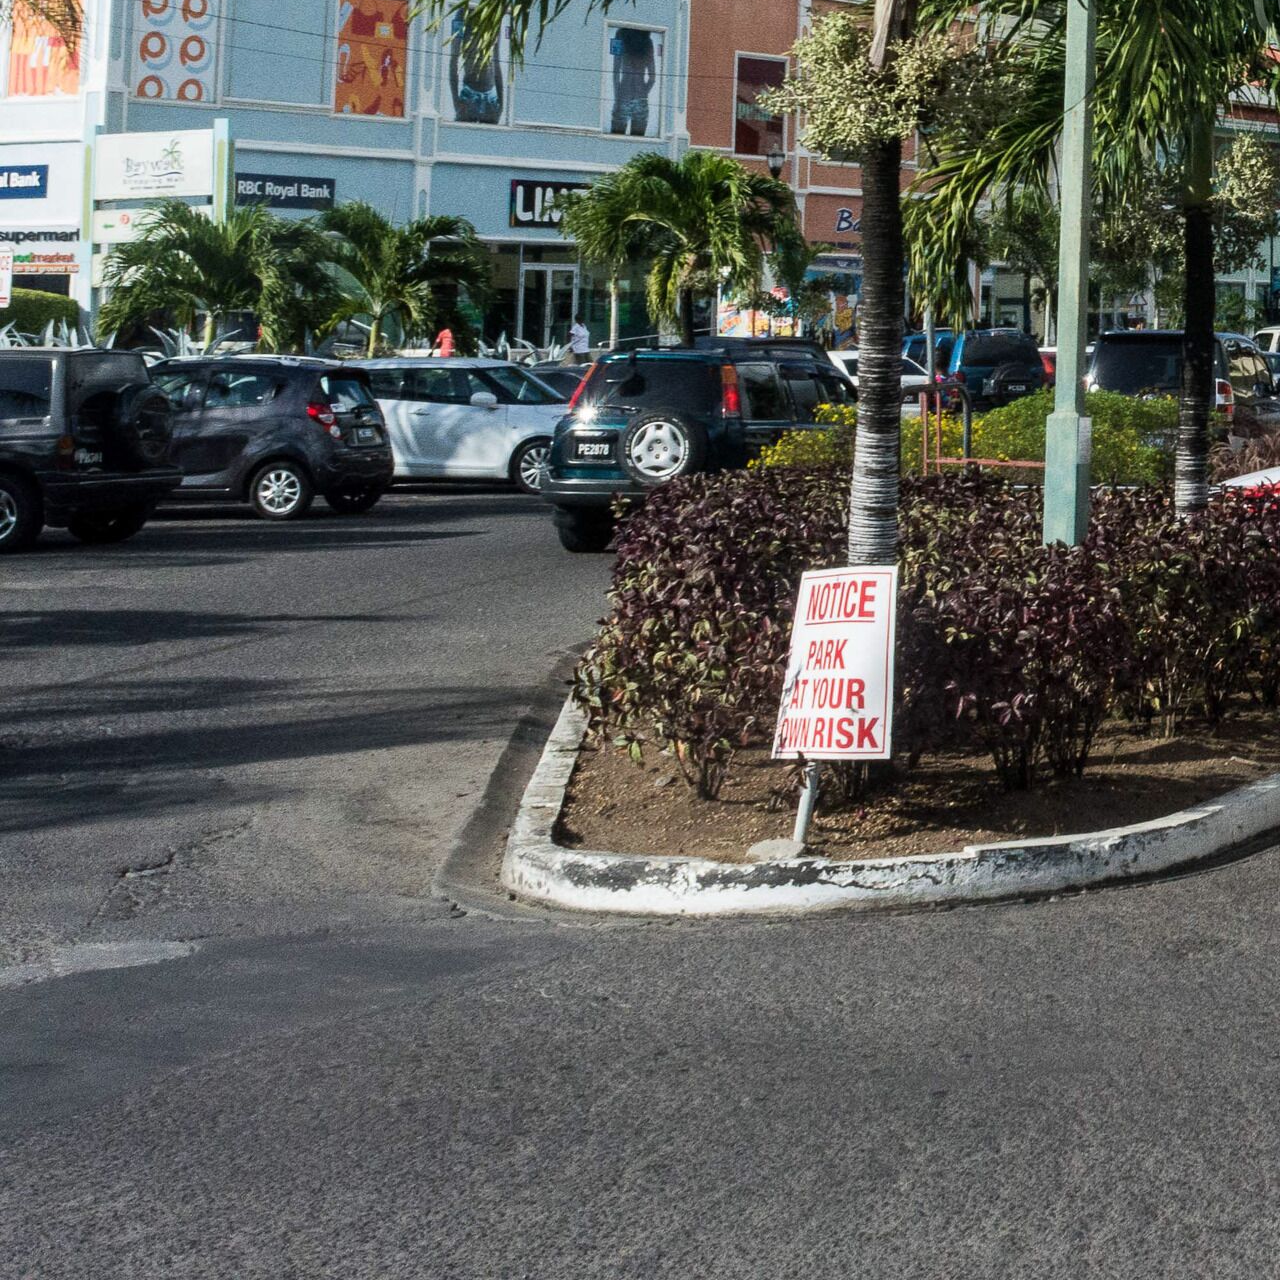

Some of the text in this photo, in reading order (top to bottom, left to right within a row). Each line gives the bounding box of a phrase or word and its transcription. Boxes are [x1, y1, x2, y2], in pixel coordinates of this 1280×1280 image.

[10, 170, 41, 188] Bank
[237, 180, 331, 200] RBC Royal Bank
[515, 184, 592, 223] LIM
[0, 227, 80, 245] supermar
[806, 580, 878, 621] NOTICE
[806, 639, 848, 671] PARK
[789, 677, 866, 710] AT YOUR
[779, 717, 880, 751] OWN RISK
